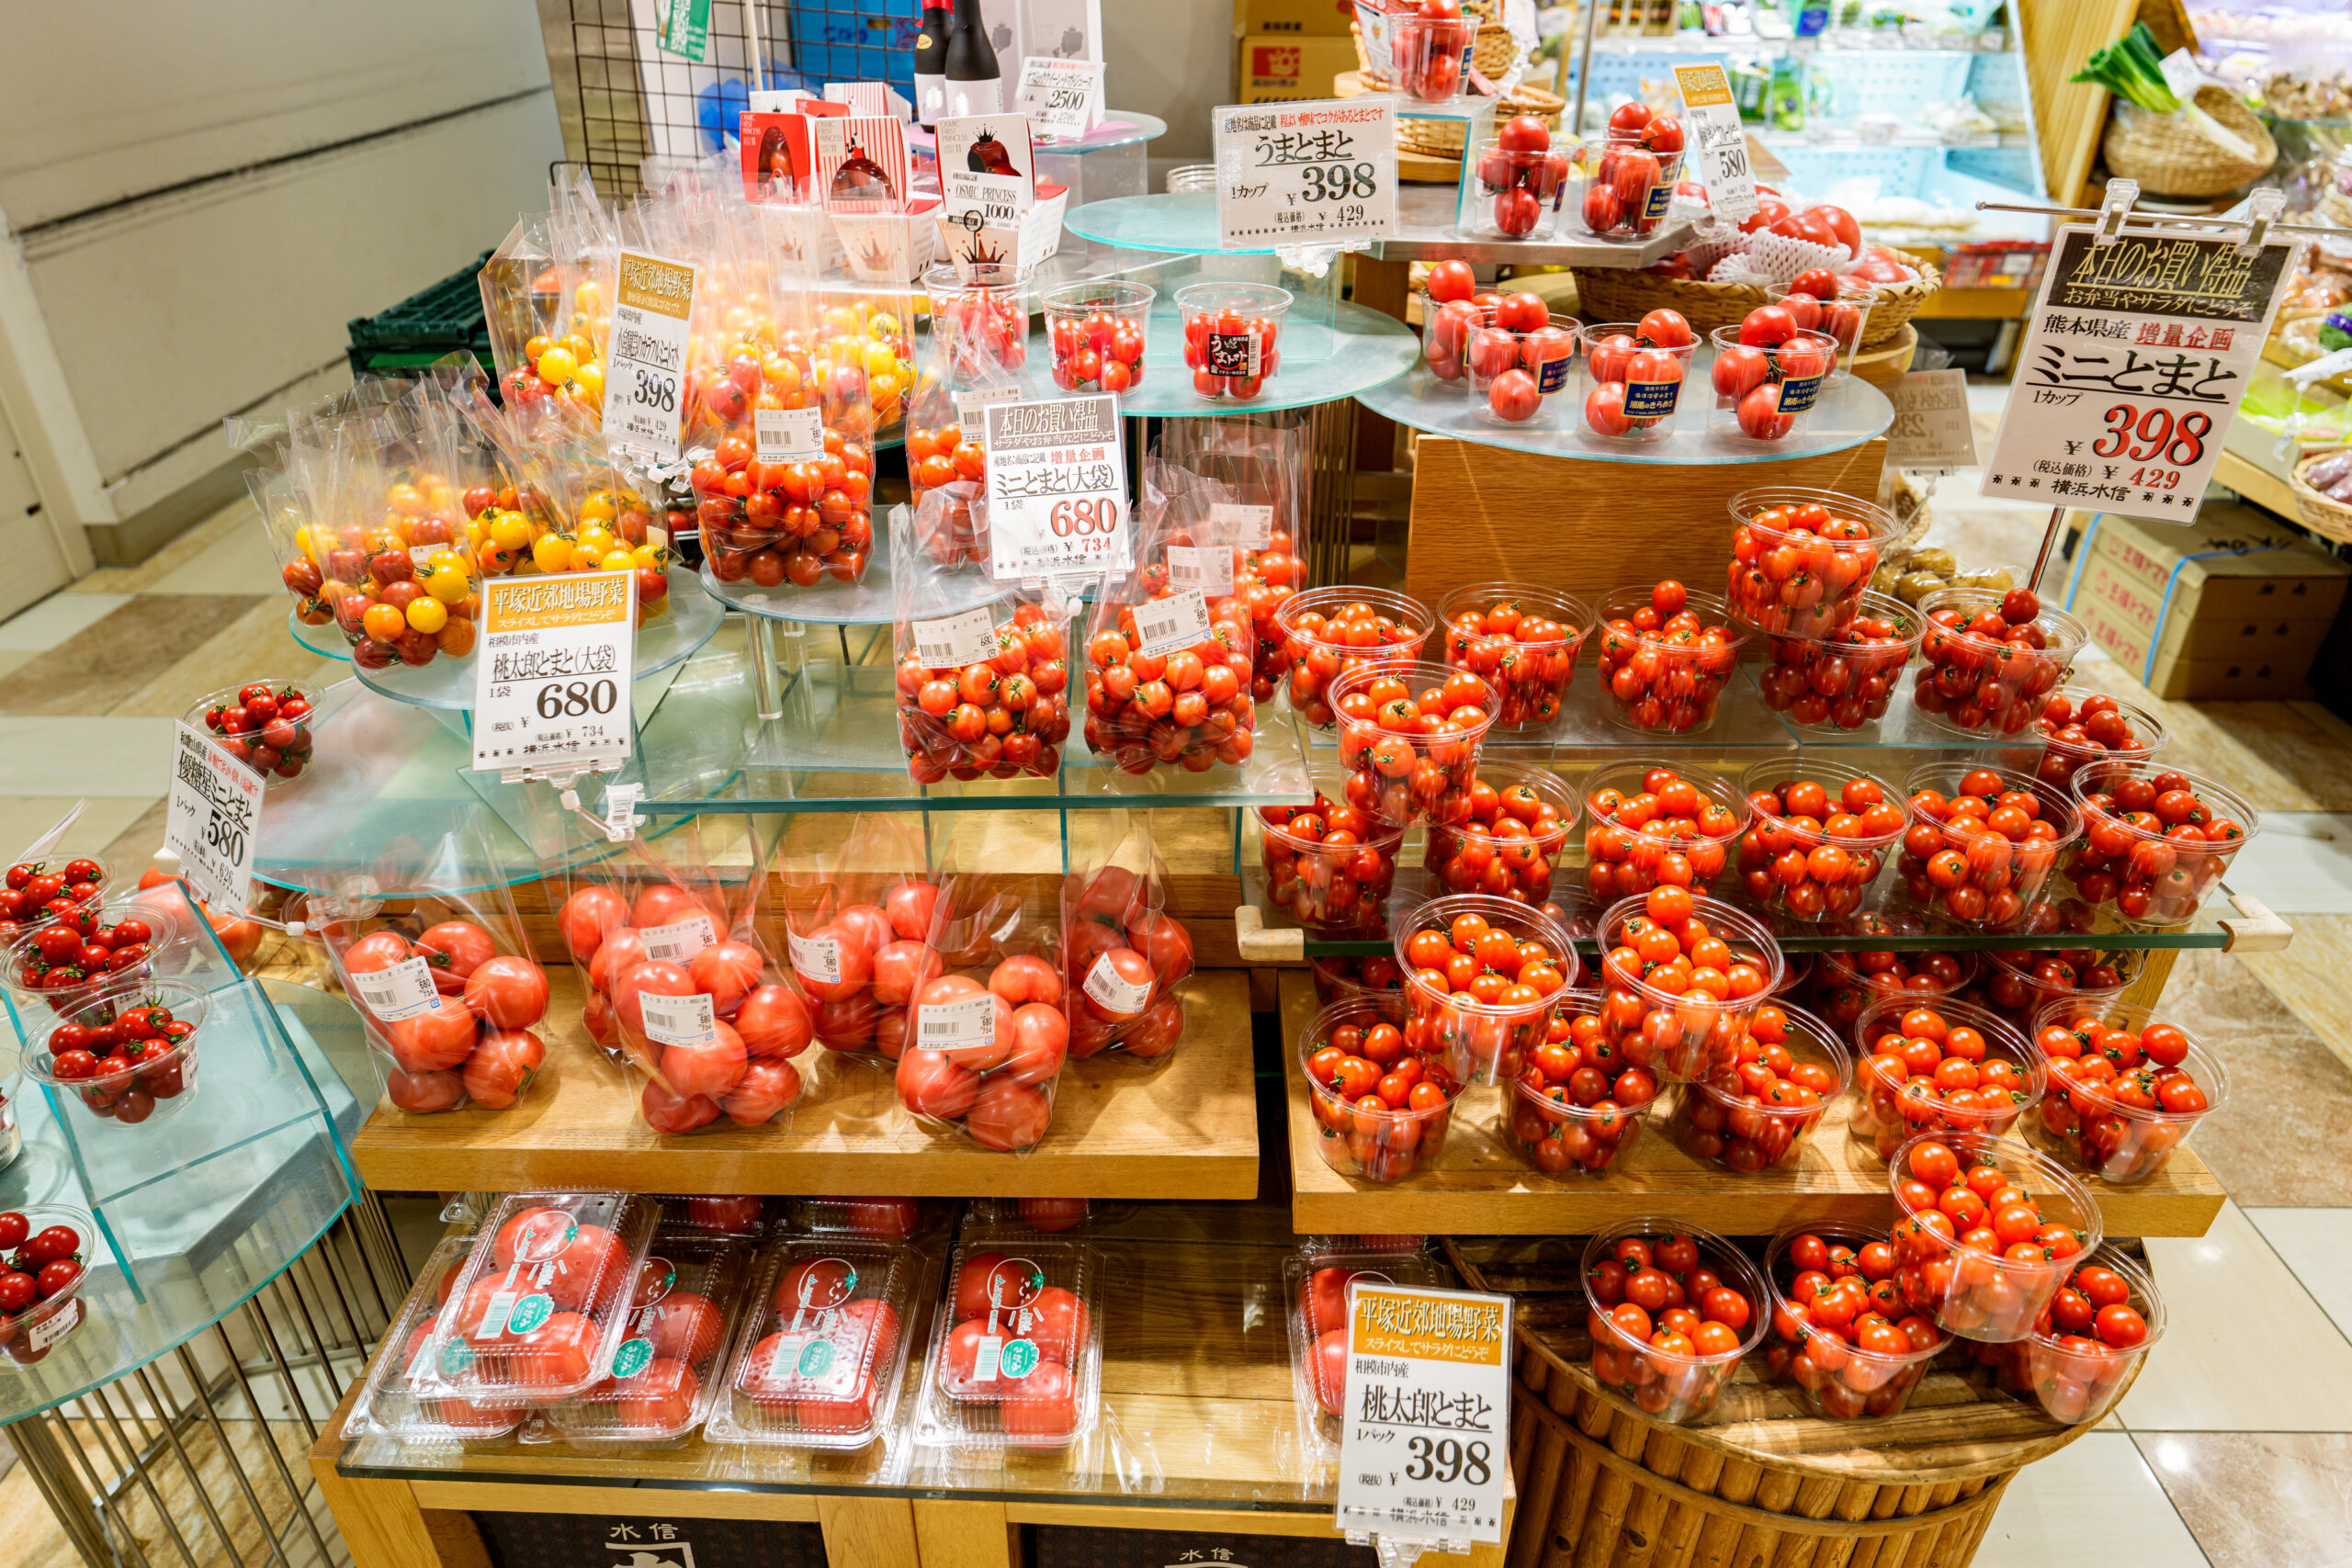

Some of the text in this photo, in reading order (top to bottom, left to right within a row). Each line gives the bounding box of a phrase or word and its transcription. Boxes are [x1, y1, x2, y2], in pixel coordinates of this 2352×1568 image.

[1048, 89, 1084, 111] 2500
[942, 134, 969, 142] PRINCESS
[1255, 130, 1353, 164] うまとまと
[1721, 150, 1746, 178] 580
[956, 185, 1017, 202] OSMIC PRINCESS
[1302, 163, 1376, 202] 398
[985, 204, 1014, 220] 1000
[1337, 205, 1364, 221] 429
[2070, 238, 2255, 297] 本日のお買い得品
[622, 259, 691, 301] 平塚近郊地場野菜
[2064, 288, 2255, 318] お弁当やサラダにどうぞ
[2042, 314, 2236, 349] 熊本県産 増量企画
[2031, 344, 2238, 400] ミニとまと
[635, 369, 676, 412] 398
[2032, 389, 2084, 407] 1カップ
[1629, 399, 1674, 410] 湘南のきらめき
[655, 420, 667, 431] 429
[999, 400, 1099, 436] 本日のお買い得品
[994, 430, 1115, 448] サラダやお弁当などにどうぞ
[2064, 403, 2213, 467] ¥ 398
[1050, 446, 1105, 464] 増量企画
[996, 464, 1114, 496] ミニとまと(大袋)
[2032, 458, 2181, 490] (税込価格) ¥ 429
[2051, 478, 2132, 502] 横浜水信
[1004, 499, 1023, 511] 1袋
[1050, 497, 1117, 537] 680
[1081, 536, 1111, 552] 734
[493, 578, 625, 615] 平塚近郊地場野菜
[497, 610, 616, 628] スライスしてサラダにどうぞ
[488, 633, 539, 649] 相模市内産
[980, 635, 992, 647] 680
[492, 644, 616, 681] 桃太郎とまと(大袋)
[490, 685, 511, 698] 1袋
[521, 716, 529, 728] ¥
[537, 679, 617, 719] 680
[582, 725, 604, 737] 734
[177, 750, 253, 831] 優糖星ミニとまと
[208, 808, 243, 867] 580
[220, 863, 233, 886] 626
[419, 978, 431, 989] 680
[518, 1301, 537, 1328] さがみ
[1360, 1296, 1500, 1344] 平塚近郊地場野菜
[620, 1345, 639, 1371] さがみ
[807, 1346, 822, 1371] さがみ
[1012, 1346, 1024, 1371] さがみ
[1364, 1337, 1490, 1361] スライスしてサラダにどうぞ
[1355, 1358, 1409, 1379] 相模市内産
[1361, 1383, 1493, 1430] 桃太郎とまと
[1356, 1428, 1396, 1443] 1パック
[1358, 1436, 1491, 1486] (税抜) ¥ 398
[1435, 1496, 1443, 1508] ¥
[1452, 1497, 1476, 1512] 429
[609, 1523, 679, 1541] 水信
[1179, 1547, 1234, 1562] 水信
